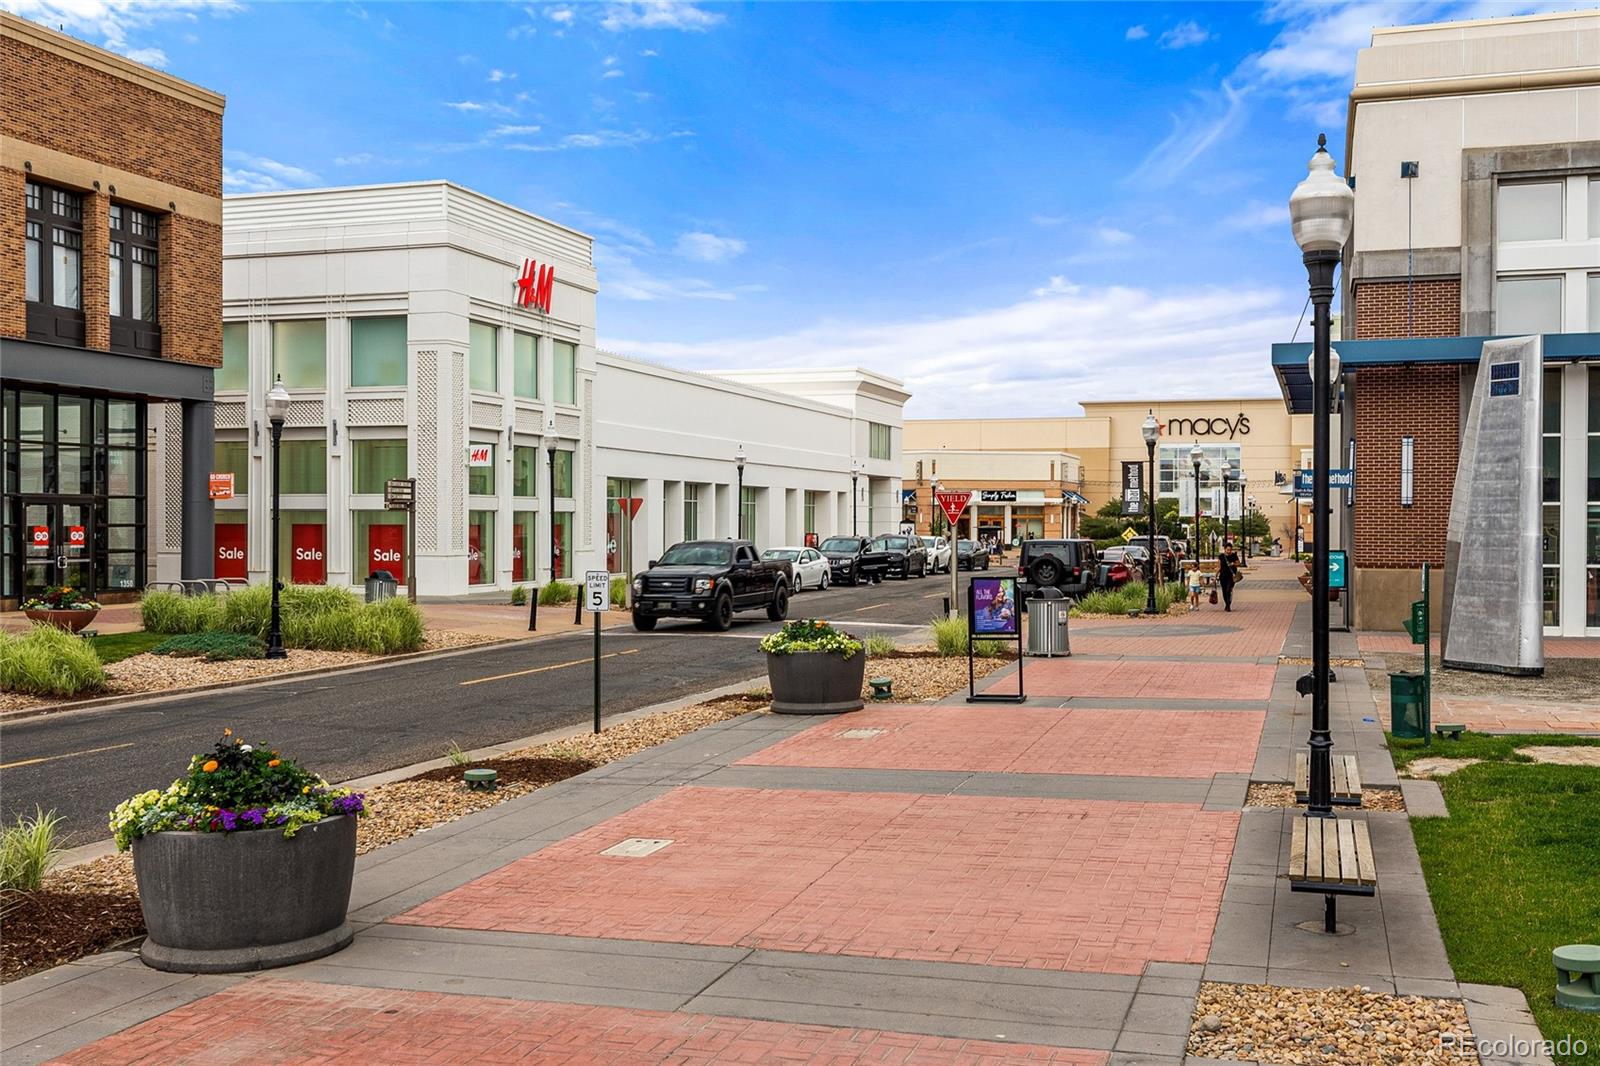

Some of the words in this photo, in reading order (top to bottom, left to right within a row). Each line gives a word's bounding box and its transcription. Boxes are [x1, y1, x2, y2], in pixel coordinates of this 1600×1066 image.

[517, 258, 554, 314] H&M
[1329, 473, 1350, 484] ethod
[218, 546, 244, 560] Sale
[296, 547, 323, 561] Sale
[373, 548, 401, 562] Sale
[592, 591, 603, 606] 5
